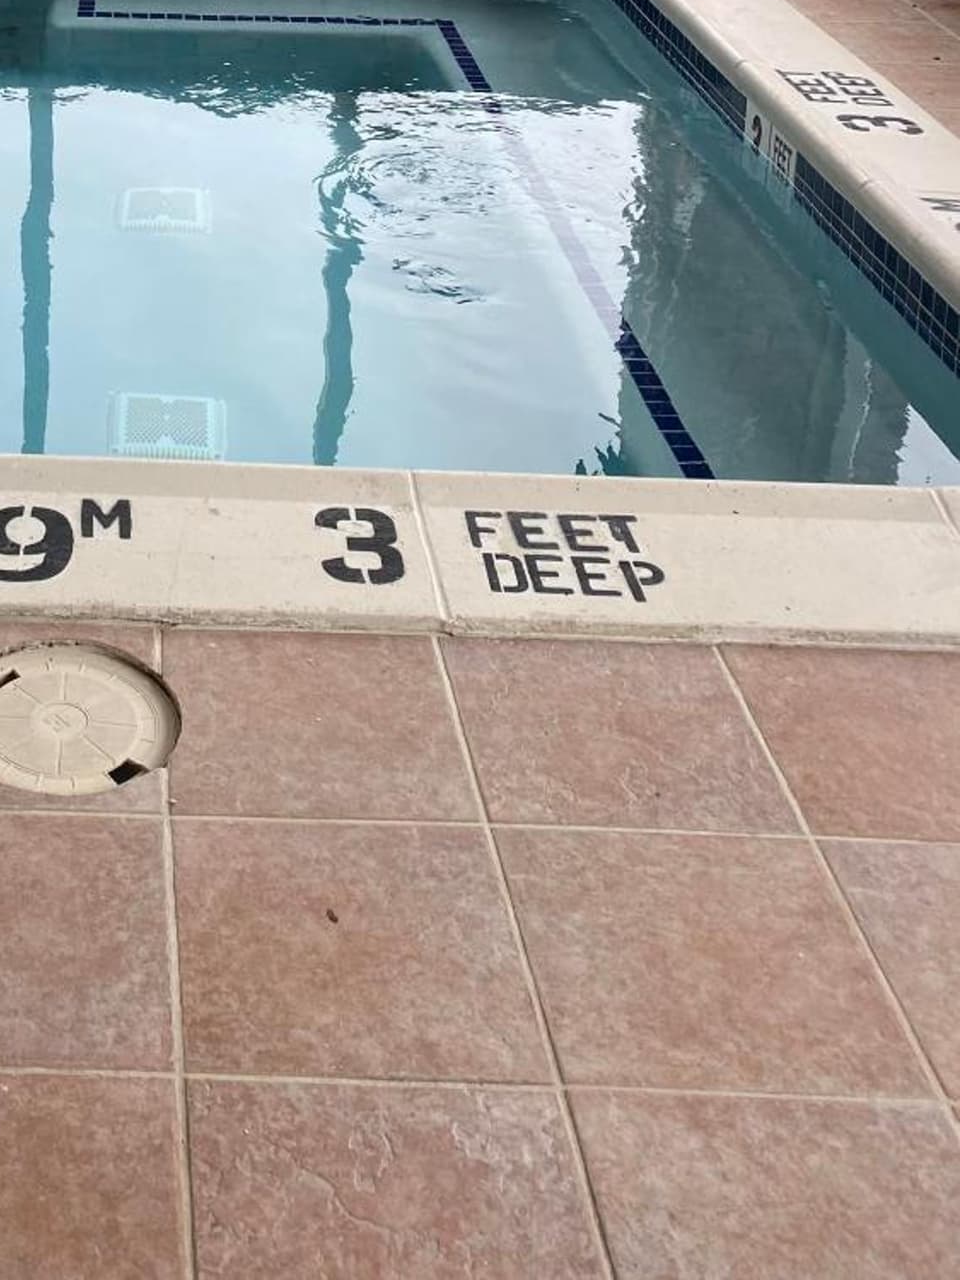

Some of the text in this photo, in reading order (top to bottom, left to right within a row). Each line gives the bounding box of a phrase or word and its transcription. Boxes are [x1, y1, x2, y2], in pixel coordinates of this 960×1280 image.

[775, 69, 848, 103] FEET
[821, 71, 894, 107] DEEP
[836, 114, 925, 136] 3
[313, 507, 407, 587] 3
[464, 511, 642, 553] FEET
[484, 554, 666, 603] DEEP
